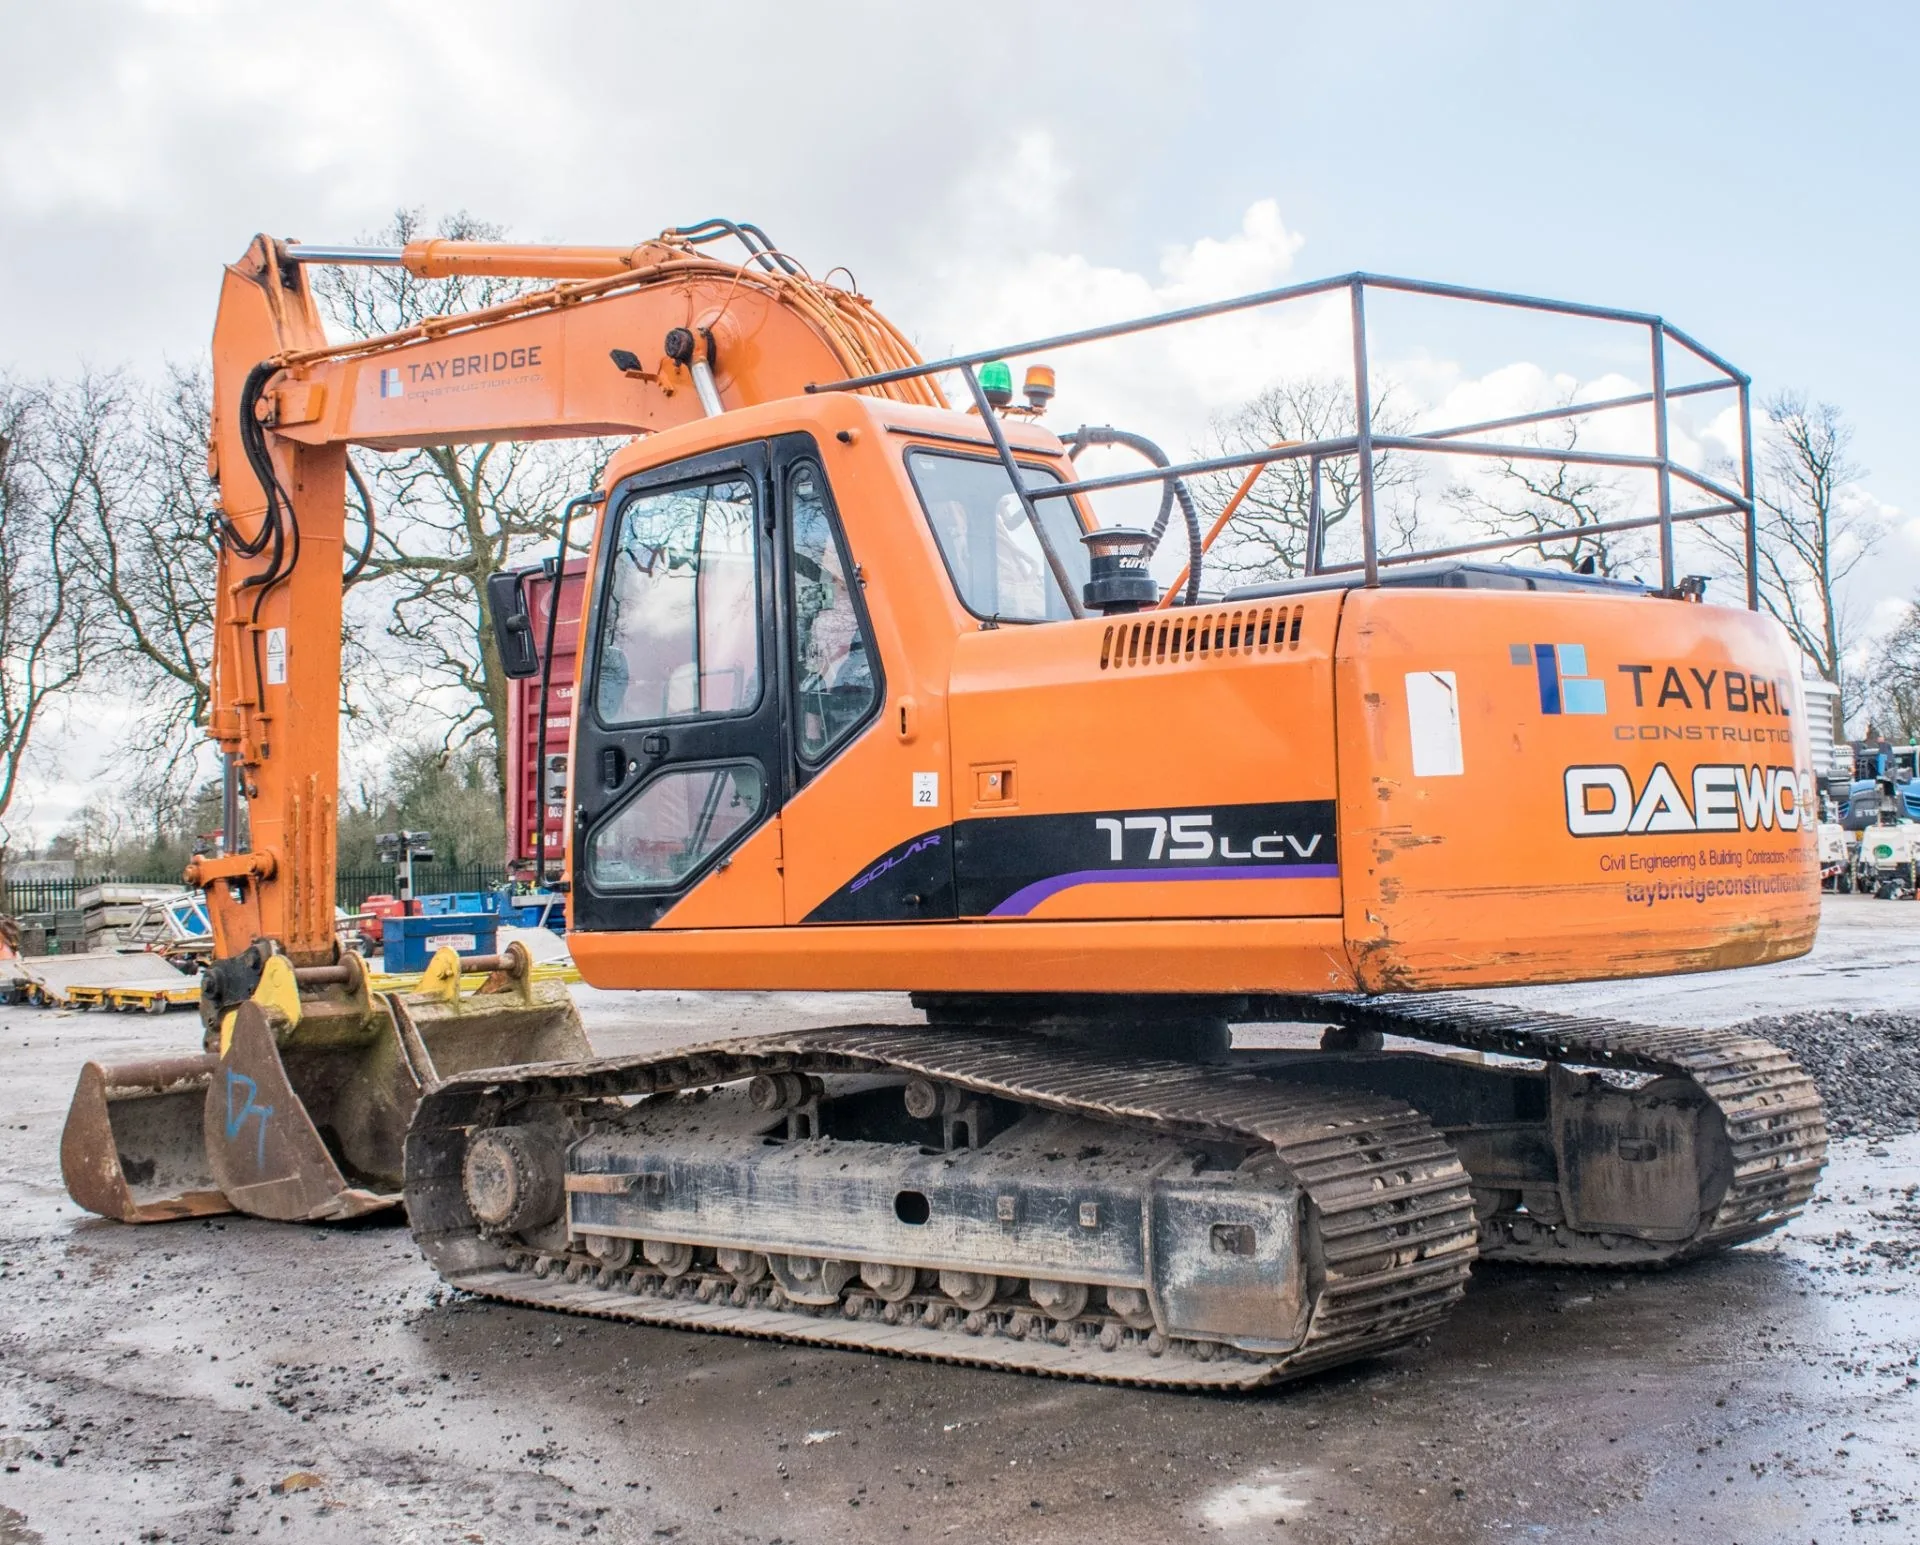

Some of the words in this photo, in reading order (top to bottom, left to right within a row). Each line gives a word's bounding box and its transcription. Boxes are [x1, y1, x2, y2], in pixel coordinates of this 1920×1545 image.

[408, 346, 542, 383] TAYBRIDGE
[919, 790, 931, 802] 22
[849, 835, 941, 894] SOLAR
[1600, 855, 1626, 872] Civil
[1630, 852, 1696, 873] Engineering
[1699, 850, 1708, 866] &
[1709, 849, 1742, 868] Building
